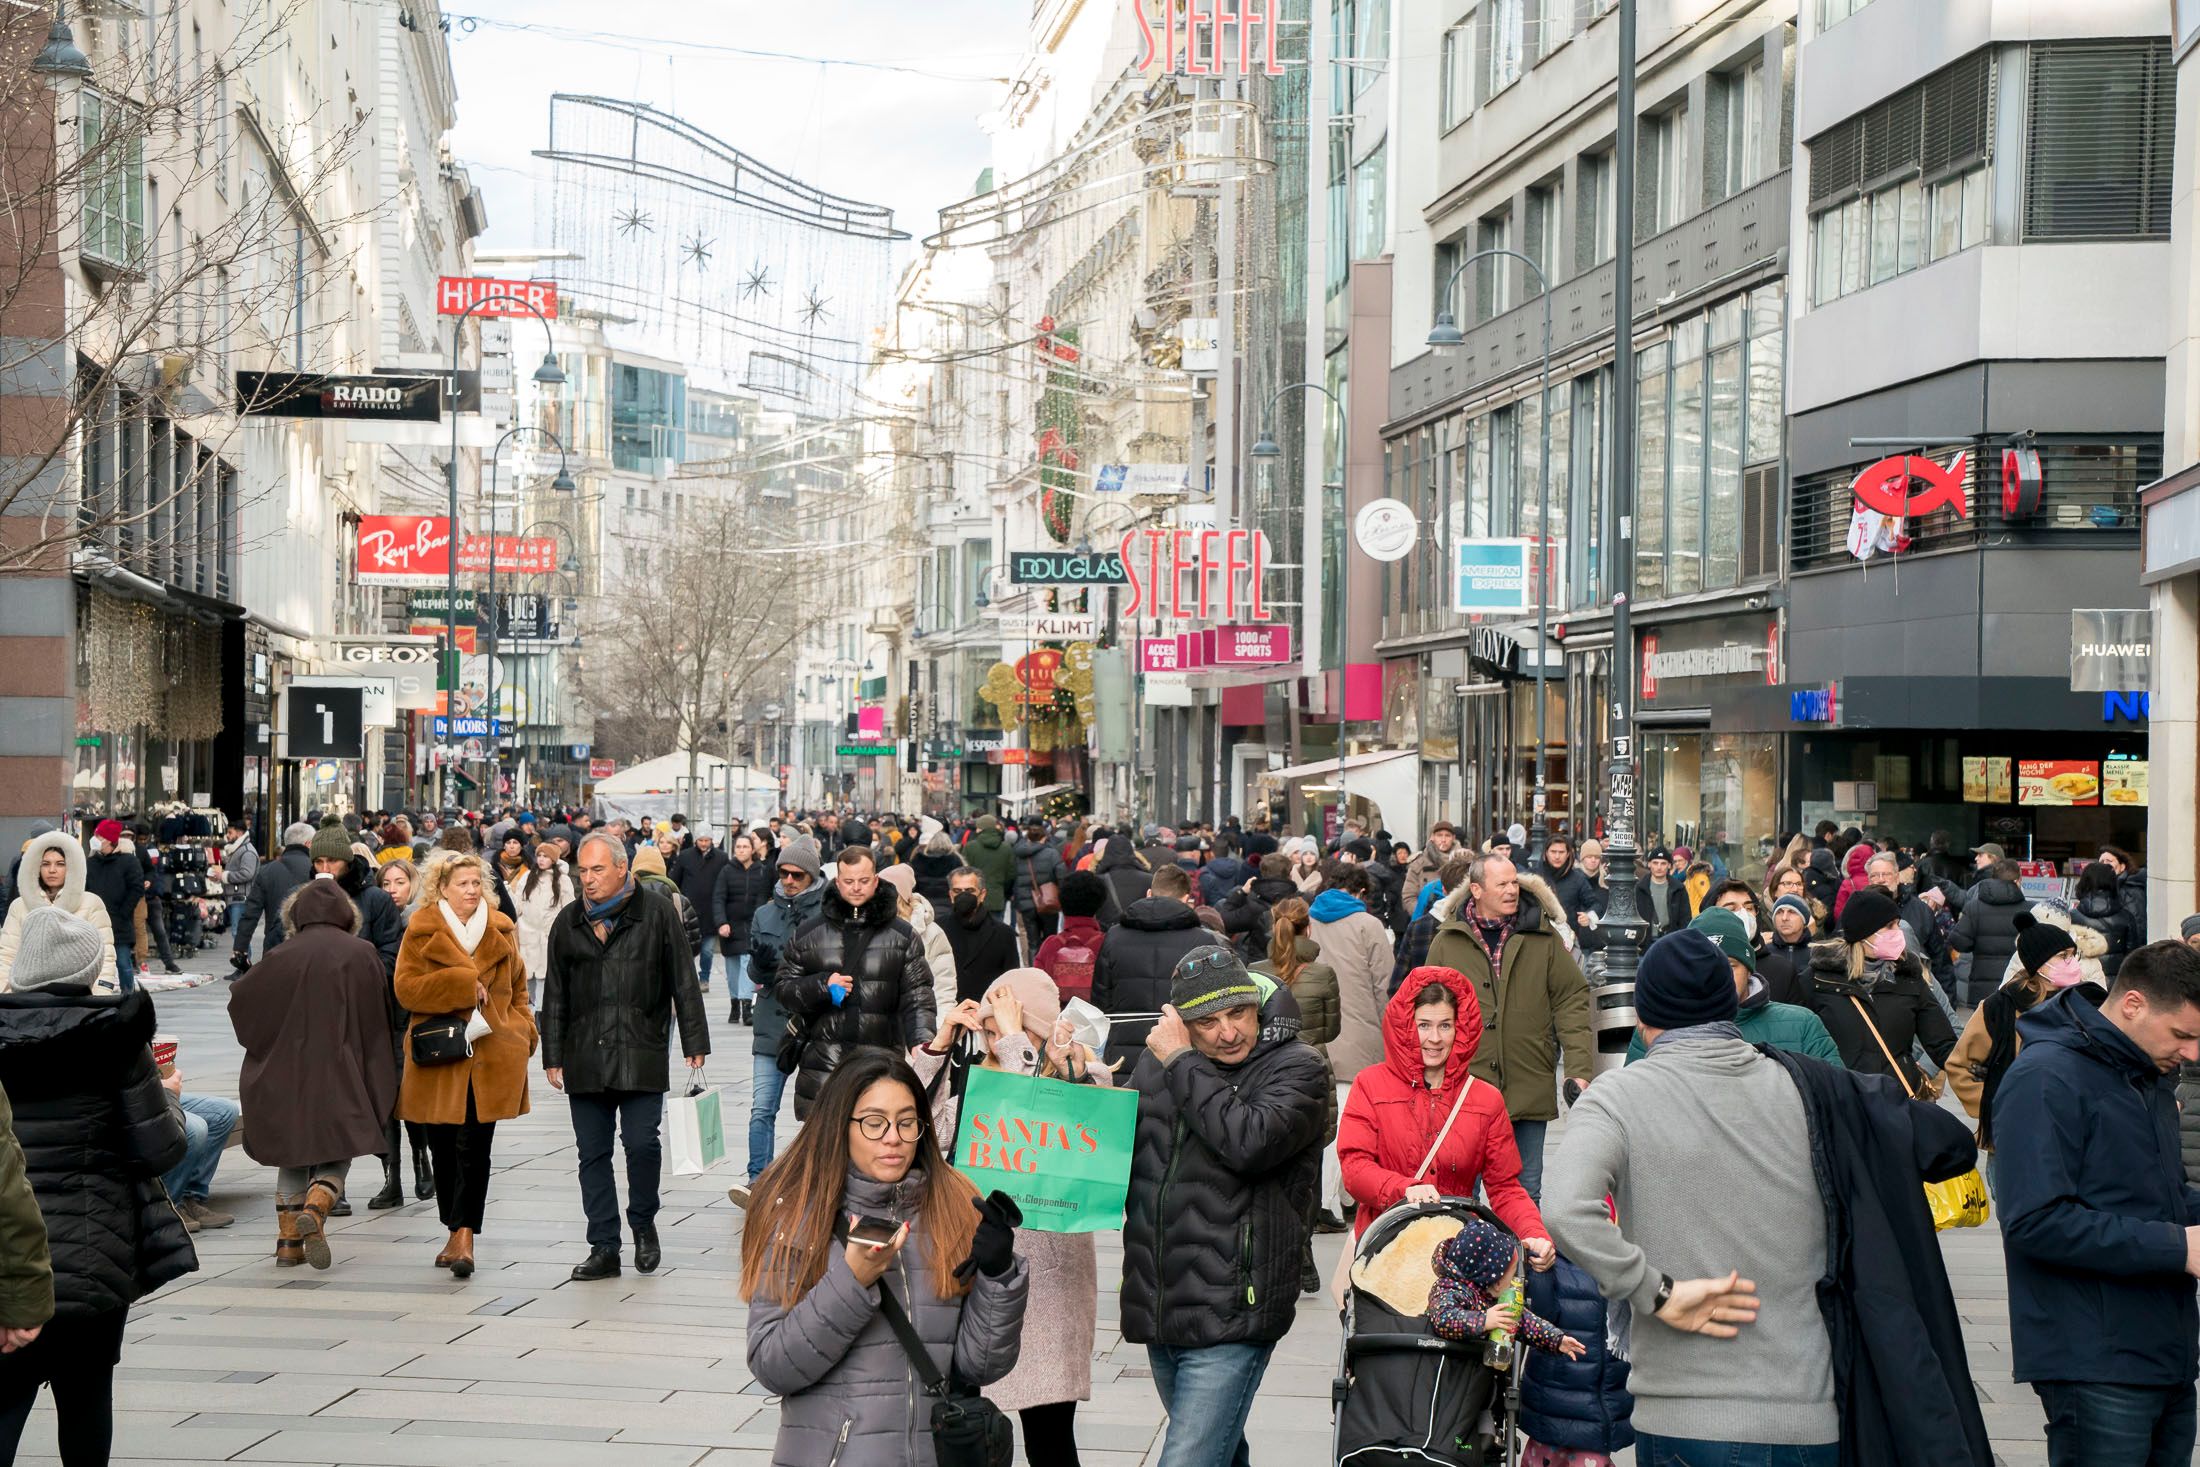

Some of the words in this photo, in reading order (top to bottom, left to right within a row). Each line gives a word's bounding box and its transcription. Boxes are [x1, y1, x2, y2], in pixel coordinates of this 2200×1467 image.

[1134, 0, 1285, 75] STEFFL
[443, 281, 546, 312] HUBER
[334, 386, 401, 402] RADO
[333, 402, 402, 410] SWITZERLAND
[1019, 558, 1123, 580] DOUGLAS
[1119, 530, 1271, 618] STEFFL
[1461, 566, 1520, 576] AMERICAN
[1473, 579, 1522, 589] EXPRESS
[1037, 619, 1093, 634] KLIMT
[1235, 632, 1257, 643] 1000
[346, 646, 439, 664] GEOX
[1235, 644, 1272, 657] SPORTS
[2081, 643, 2151, 656] HUAWEI
[971, 1113, 1098, 1153] SANTA'S
[968, 1141, 1037, 1174] BAG
